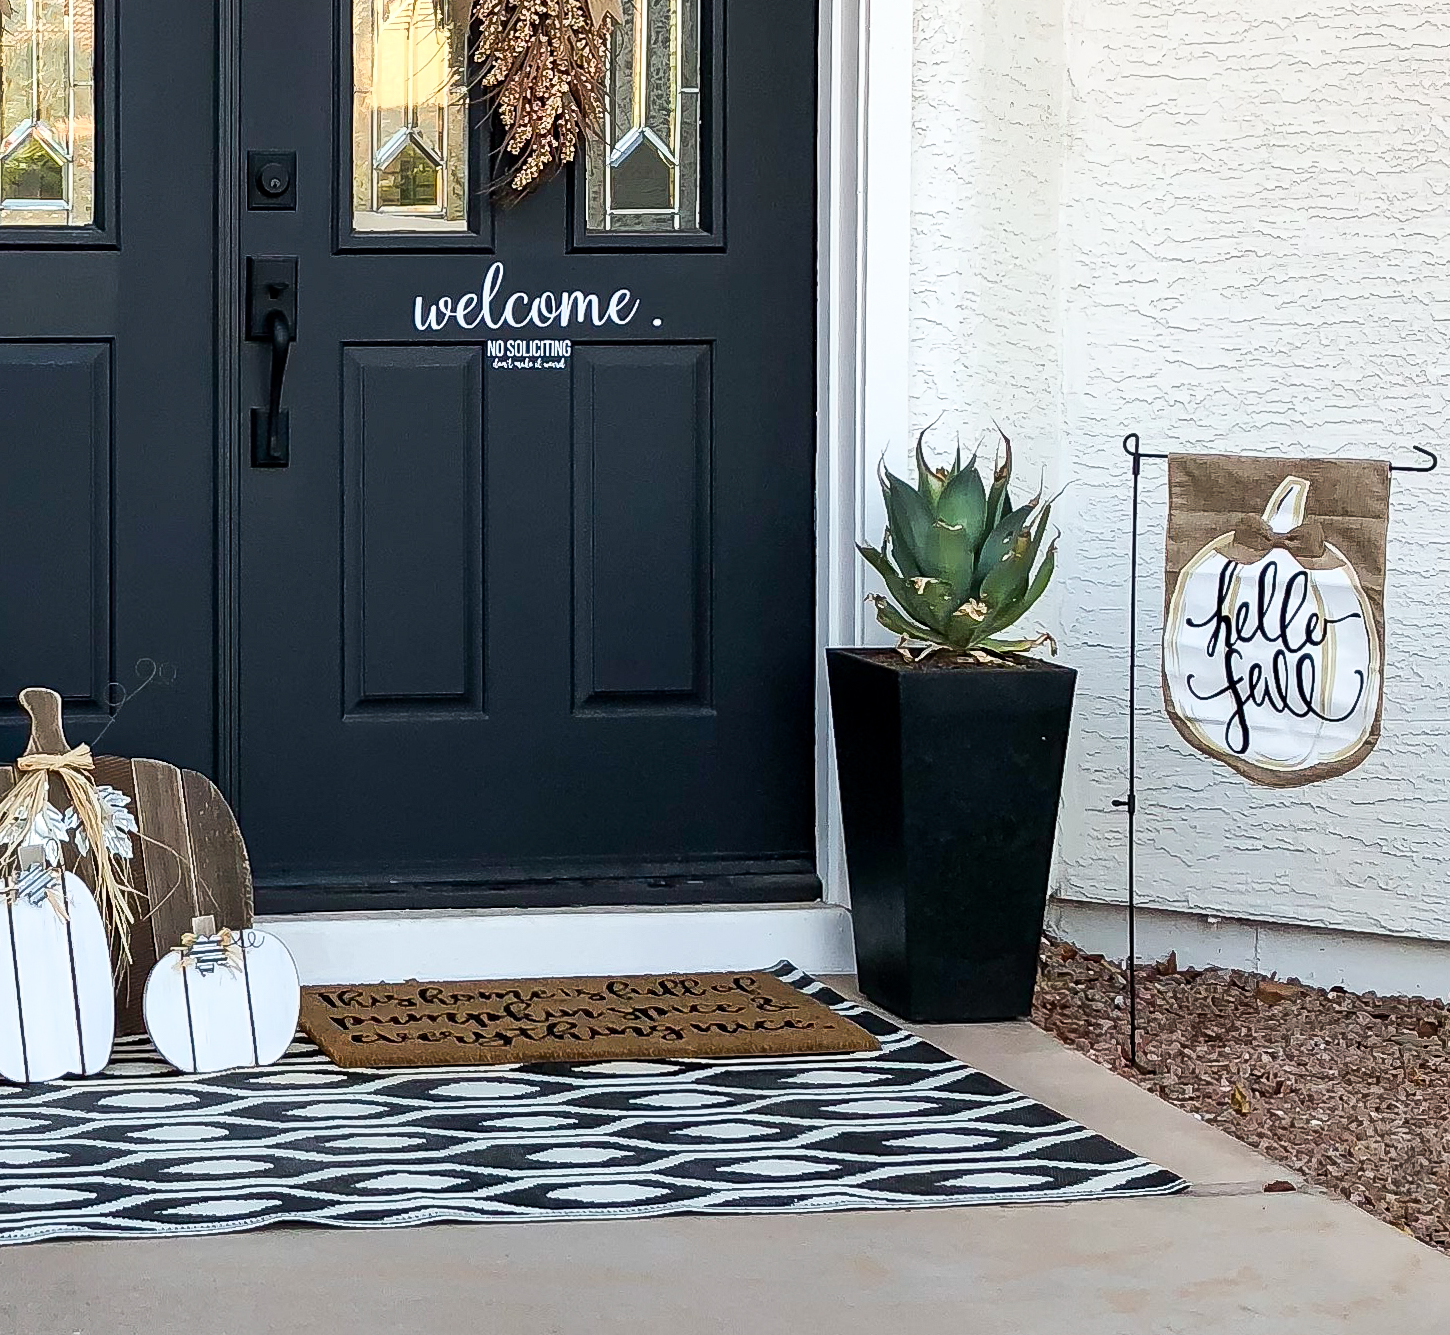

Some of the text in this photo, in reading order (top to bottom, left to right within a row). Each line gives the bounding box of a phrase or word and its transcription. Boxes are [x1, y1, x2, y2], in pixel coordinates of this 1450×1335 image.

[487, 339, 571, 357] NO SOLICITING
[1186, 560, 1362, 657] hello
[1187, 649, 1364, 754] fall
[418, 986, 556, 1006] home
[557, 986, 607, 1002] is
[606, 977, 707, 1001] full
[711, 975, 759, 995] of
[329, 995, 799, 1031] pumpkin spice &
[351, 1020, 684, 1047] everything
